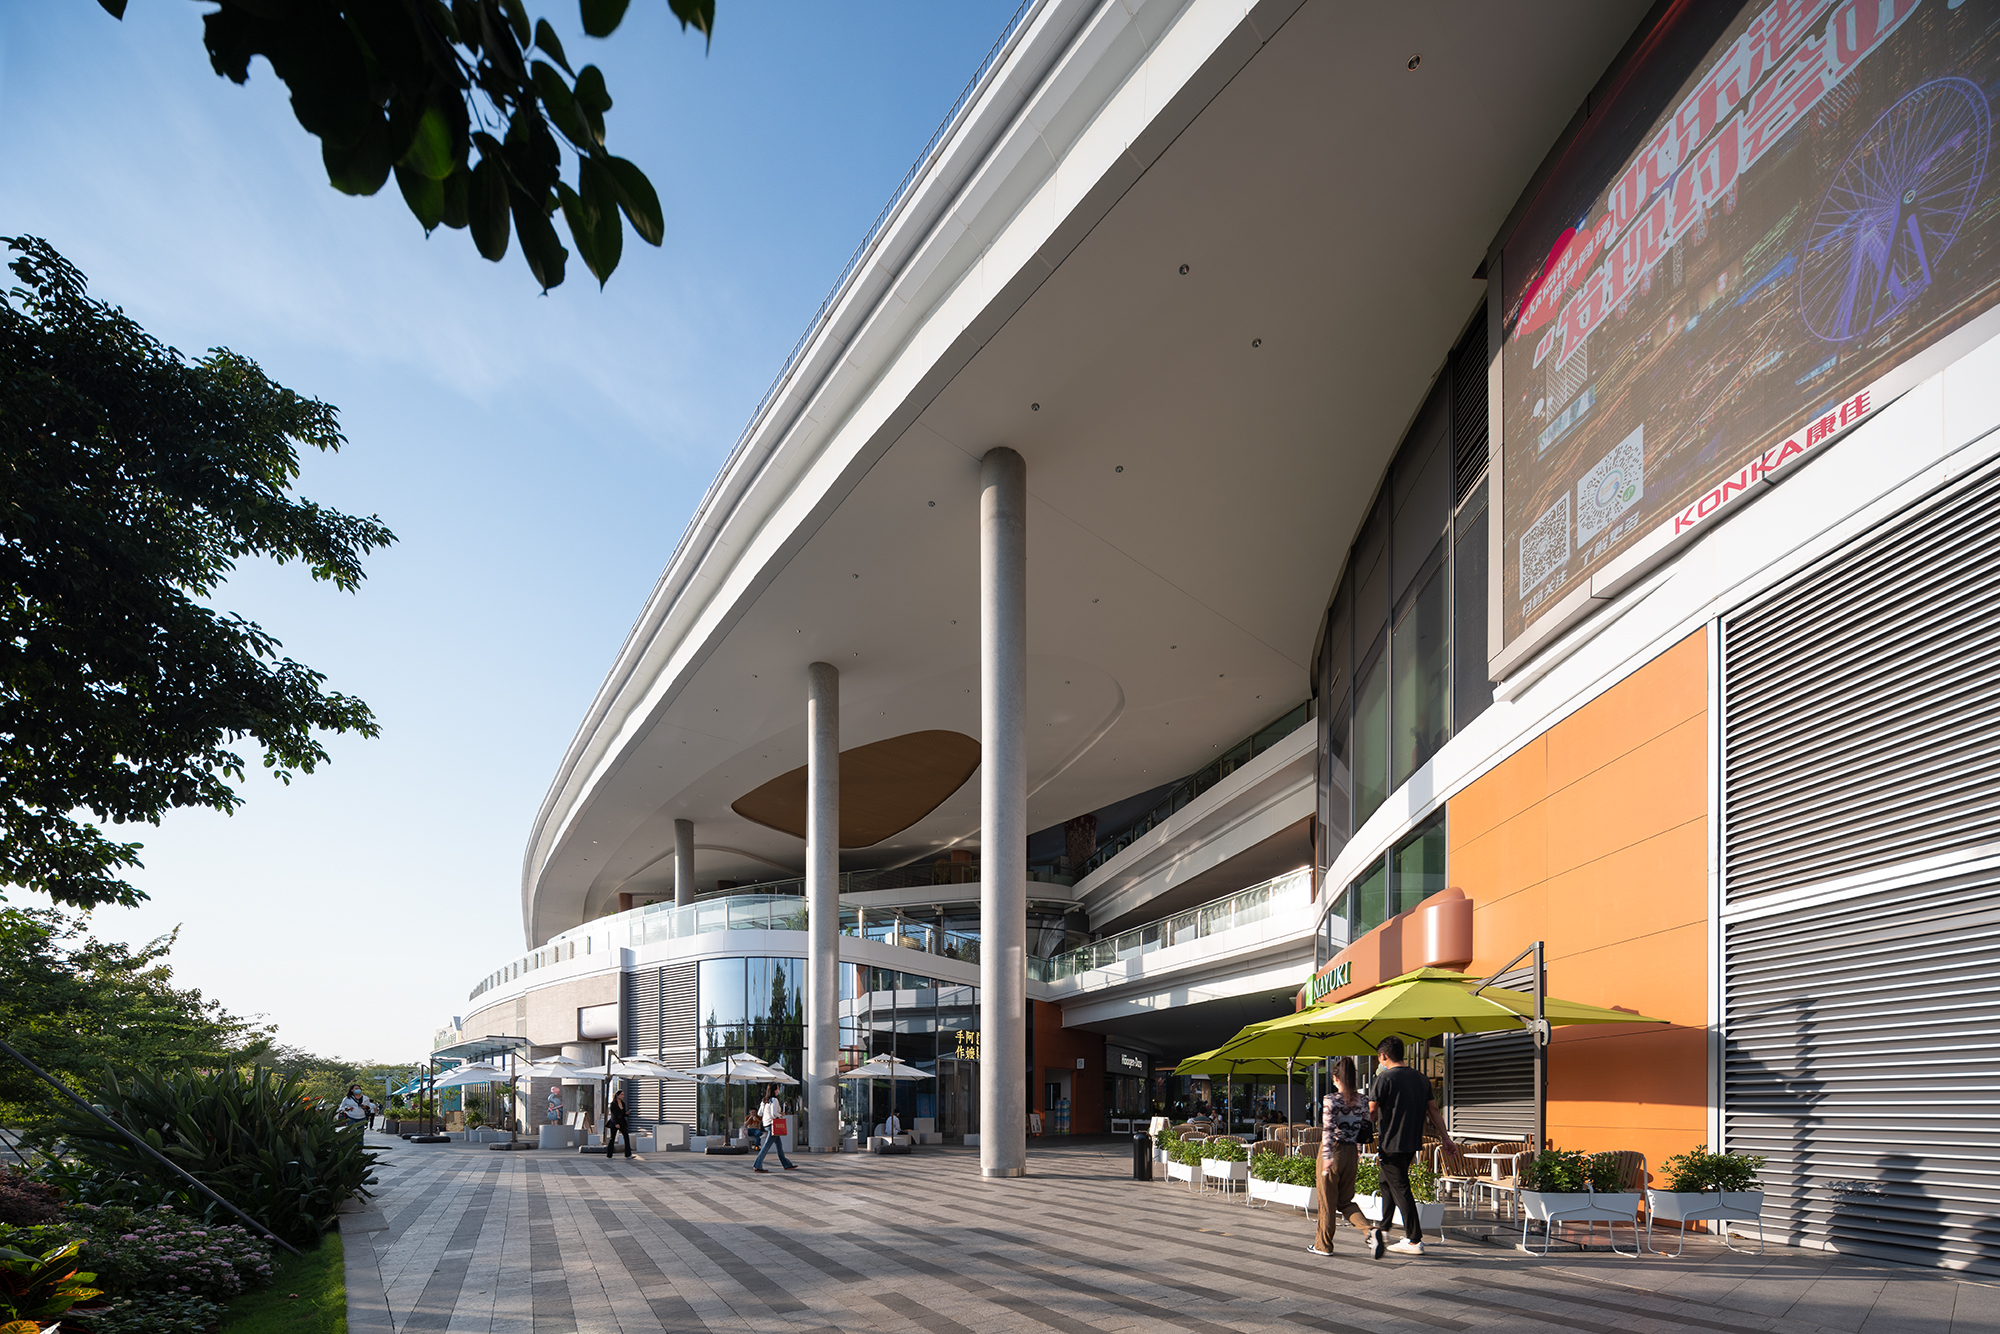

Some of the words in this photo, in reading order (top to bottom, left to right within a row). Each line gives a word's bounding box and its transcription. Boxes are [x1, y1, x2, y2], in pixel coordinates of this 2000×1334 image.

[1549, 215, 1612, 309] 推荐商场
[1675, 439, 1804, 536] KONKA
[1806, 390, 1871, 449] 康佳
[1522, 569, 1568, 617] 扫码关注
[1313, 961, 1351, 1001] NAYUKI
